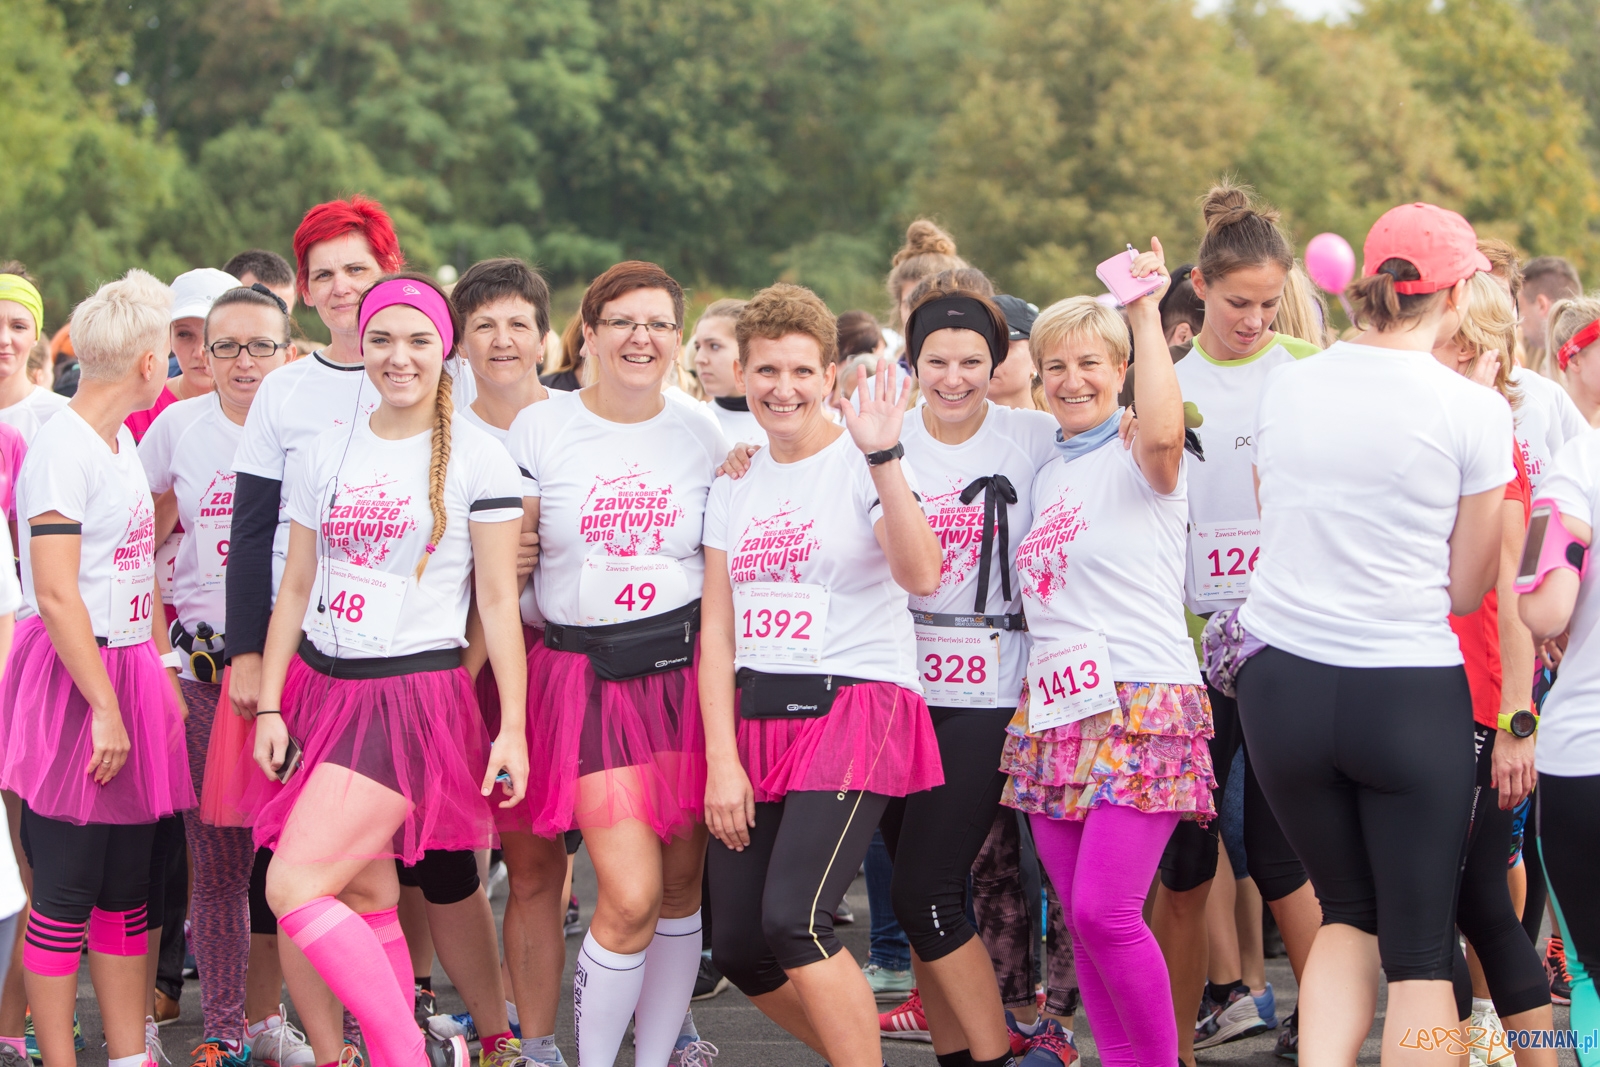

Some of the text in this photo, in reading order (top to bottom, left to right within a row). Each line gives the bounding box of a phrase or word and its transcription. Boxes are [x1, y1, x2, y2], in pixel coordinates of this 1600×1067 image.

[593, 496, 668, 512] zawsze
[330, 505, 400, 520] zawsze
[926, 513, 984, 528] awsze
[585, 529, 614, 542] 2016
[778, 527, 800, 536] KOBIET
[740, 532, 805, 552] zawsze
[118, 558, 140, 572] 2016
[371, 579, 386, 588] 2016
[614, 582, 656, 611] 49
[330, 590, 366, 623] 48
[743, 609, 812, 640] 1392
[1072, 643, 1088, 652] 2016
[919, 654, 986, 684] 328
[1038, 660, 1100, 706] 1413
